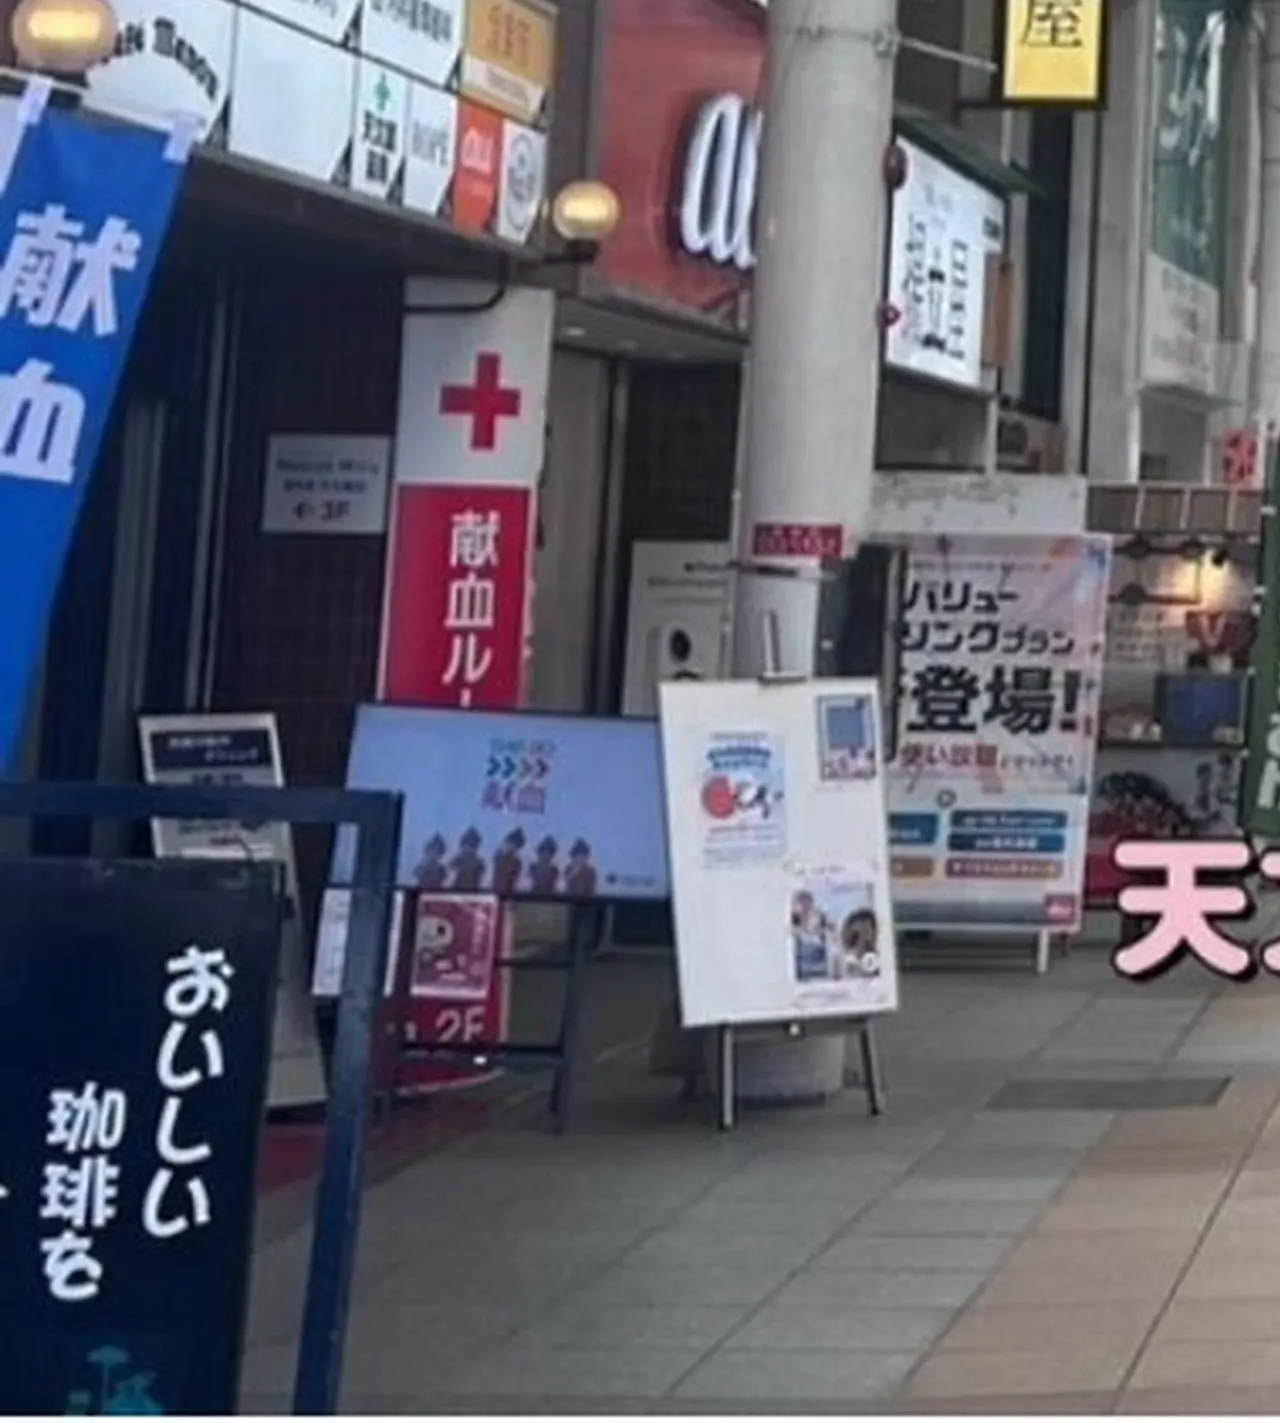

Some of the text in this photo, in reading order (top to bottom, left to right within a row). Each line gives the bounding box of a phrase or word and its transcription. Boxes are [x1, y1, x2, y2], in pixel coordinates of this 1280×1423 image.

[0, 201, 143, 485] 献血
[900, 663, 1082, 735] 登場!
[39, 1081, 129, 1303] 珈琲を
[141, 945, 235, 1239] おいしい
